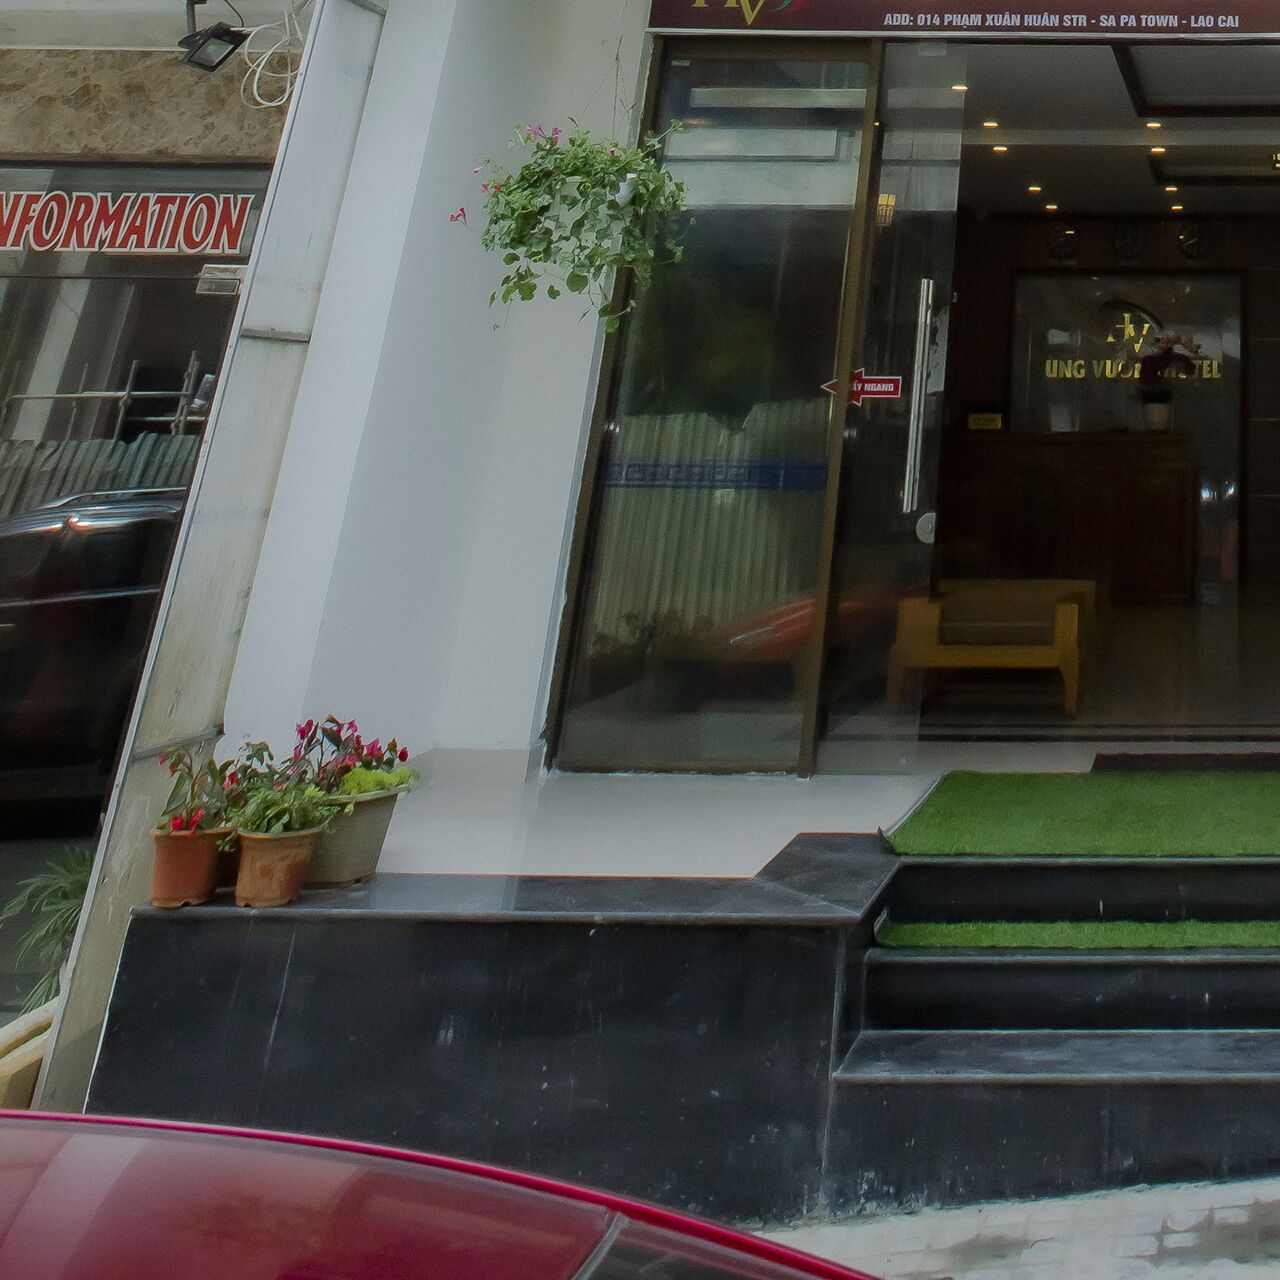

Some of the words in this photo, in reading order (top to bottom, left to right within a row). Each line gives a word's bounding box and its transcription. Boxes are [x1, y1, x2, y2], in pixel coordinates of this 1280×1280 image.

[917, 14, 940, 26] 014
[985, 12, 1020, 26] XUÂN
[1024, 12, 1059, 27] HUÂN
[1063, 15, 1087, 27] STR
[1100, 15, 1116, 27] SA
[1120, 15, 1136, 27] PA
[1140, 15, 1178, 27] TOWN
[1190, 15, 1213, 28] LAO
[1217, 15, 1240, 28] CAI
